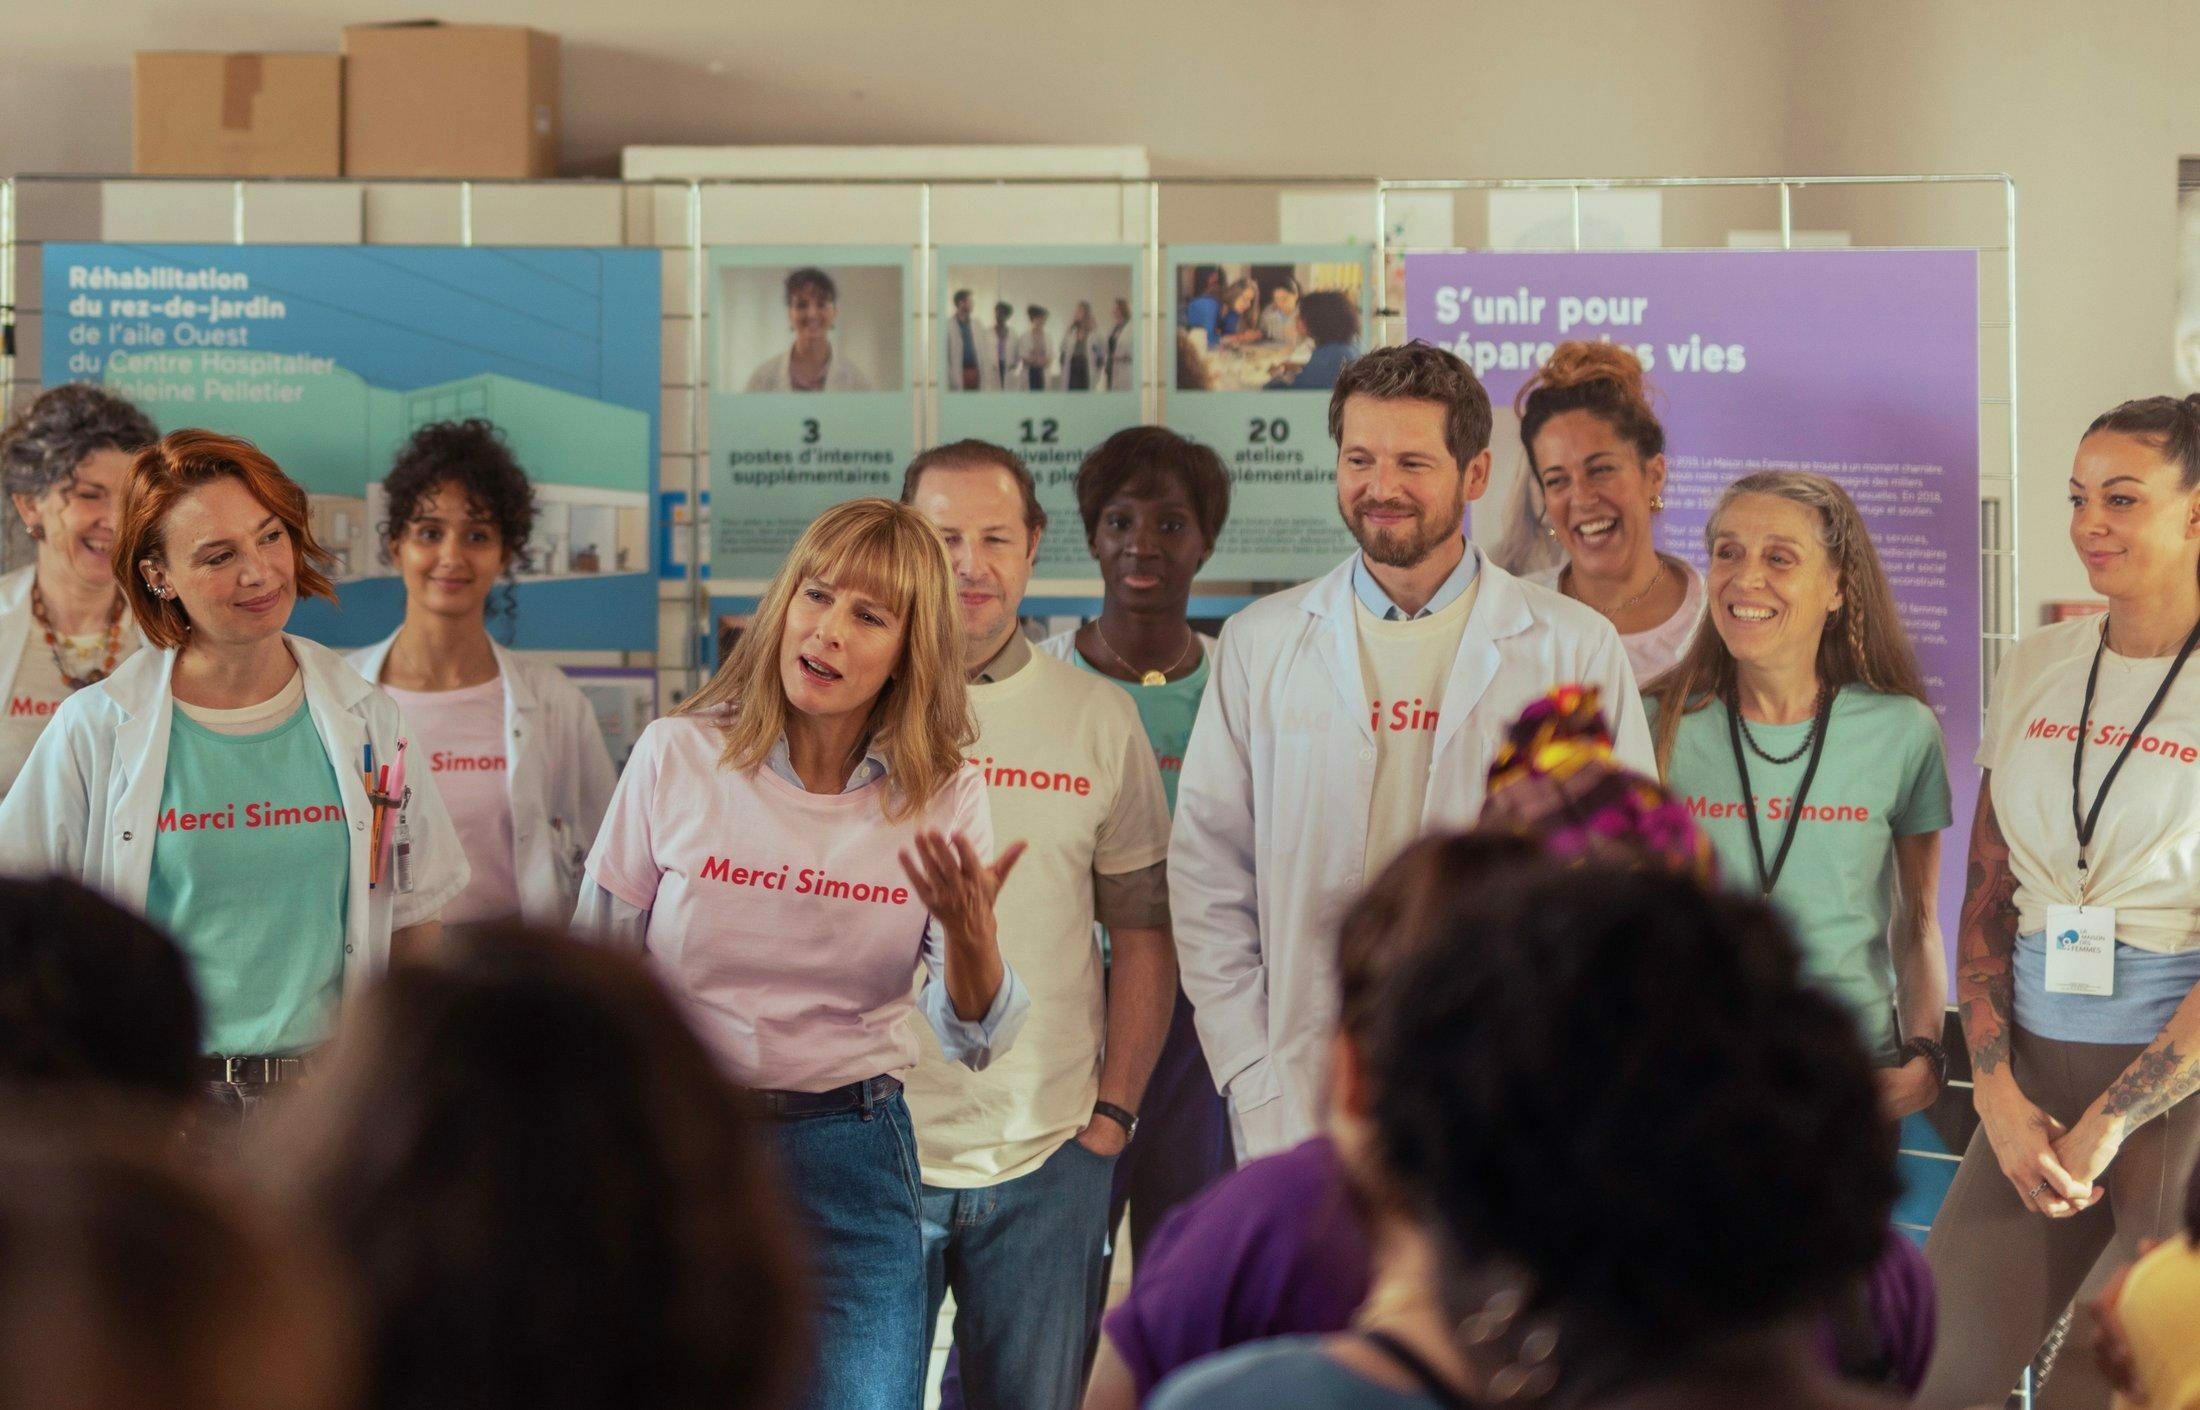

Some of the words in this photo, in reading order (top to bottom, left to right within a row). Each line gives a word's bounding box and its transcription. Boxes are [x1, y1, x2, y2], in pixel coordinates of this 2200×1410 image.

[68, 265, 249, 291] Réhabilitation
[68, 293, 103, 318] du
[110, 294, 287, 324] rez-de-jardin
[1435, 285, 1546, 325] S'unir
[1559, 295, 1648, 334] pour
[68, 322, 101, 346] de
[109, 322, 167, 346] l'aile
[173, 322, 249, 347] Ouest
[68, 351, 101, 374] du
[109, 348, 194, 374] Centre
[201, 351, 336, 378] Hospitalier
[1667, 333, 1747, 373] vies
[203, 378, 305, 402] Pelletier
[803, 418, 820, 444] 3
[1020, 418, 1059, 444] 12
[1248, 417, 1290, 443] 20
[730, 449, 793, 467] postes
[800, 447, 894, 464] d'internes
[1235, 447, 1304, 464] ateliers
[733, 465, 892, 486] supplémentaires
[2093, 725, 2198, 763] Simone
[431, 751, 506, 772] Simon
[967, 757, 1091, 797] imone
[158, 803, 235, 833] Merci
[245, 800, 346, 829] Simon
[700, 856, 789, 892] Merci
[794, 867, 909, 906] Simone
